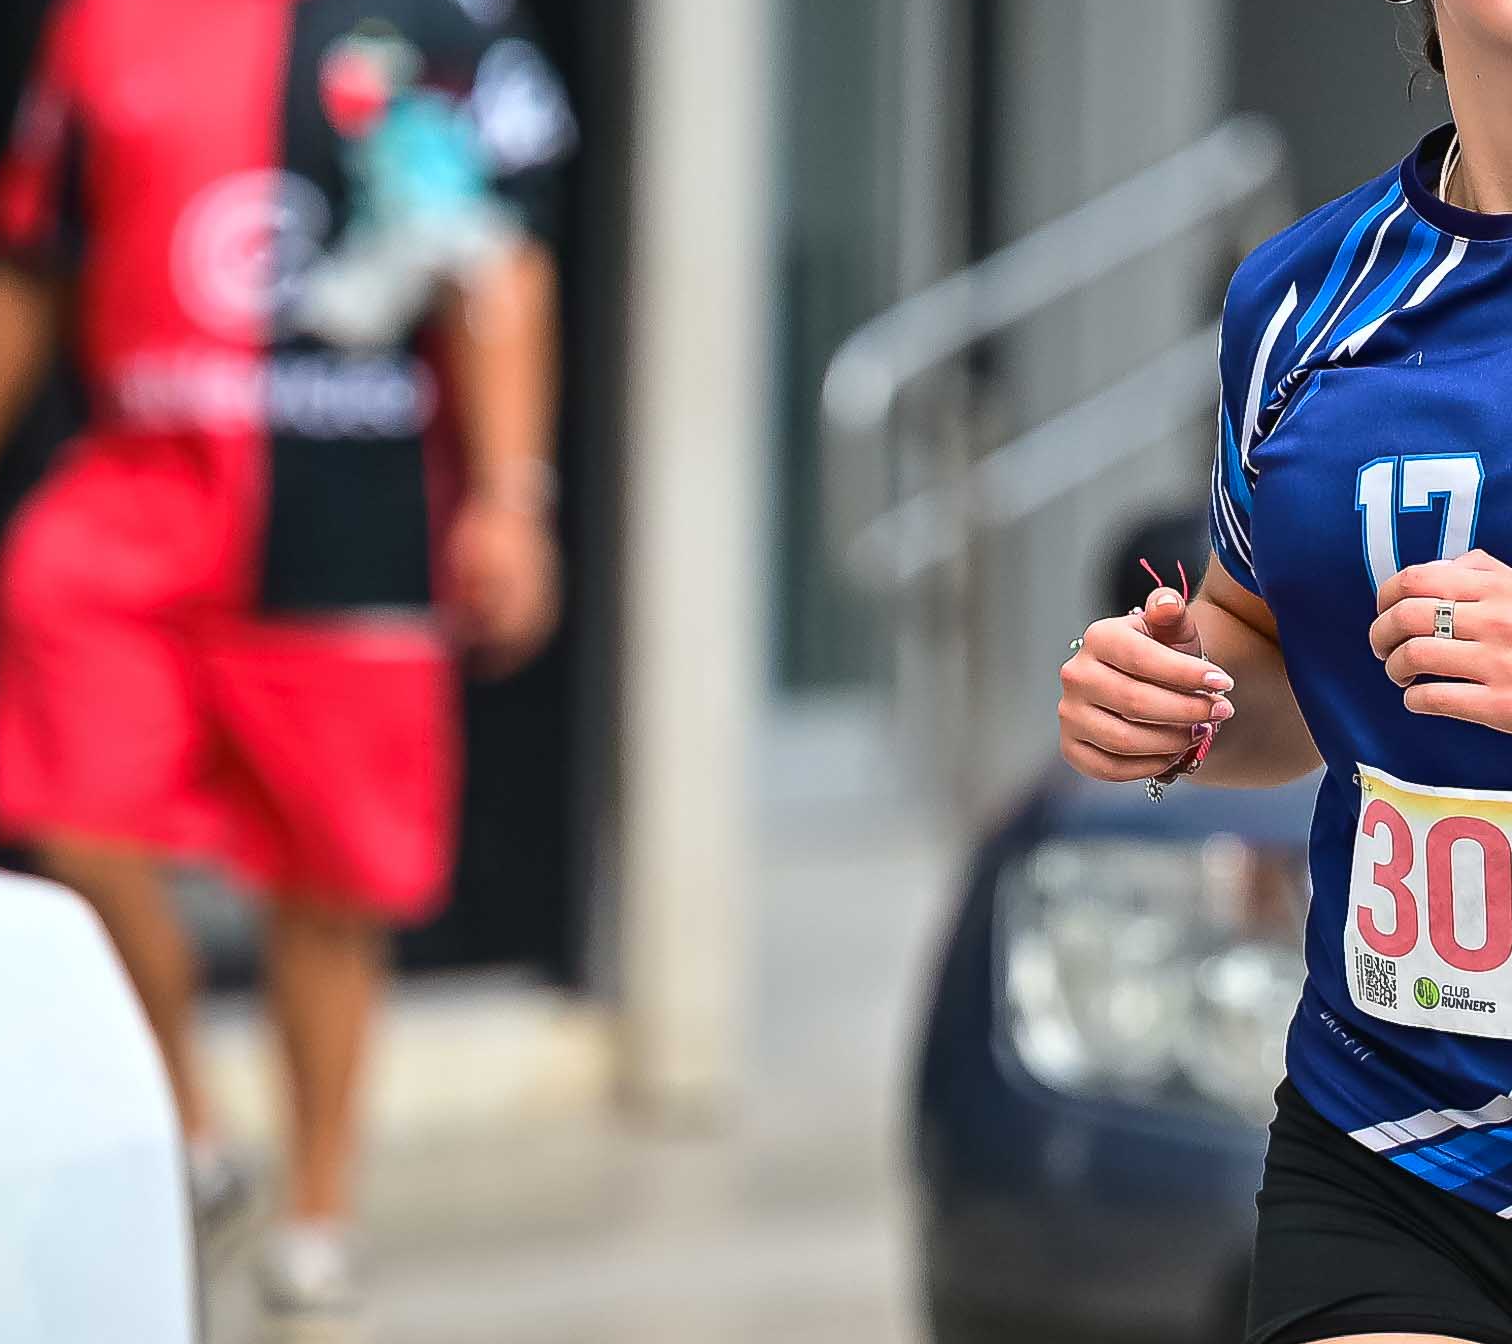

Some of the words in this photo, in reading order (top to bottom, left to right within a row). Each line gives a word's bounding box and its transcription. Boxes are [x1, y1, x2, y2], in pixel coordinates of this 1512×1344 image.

[1355, 451, 1486, 594] 17
[1441, 984, 1470, 998] CLUB
[1440, 997, 1497, 1014] RUNNER'S
